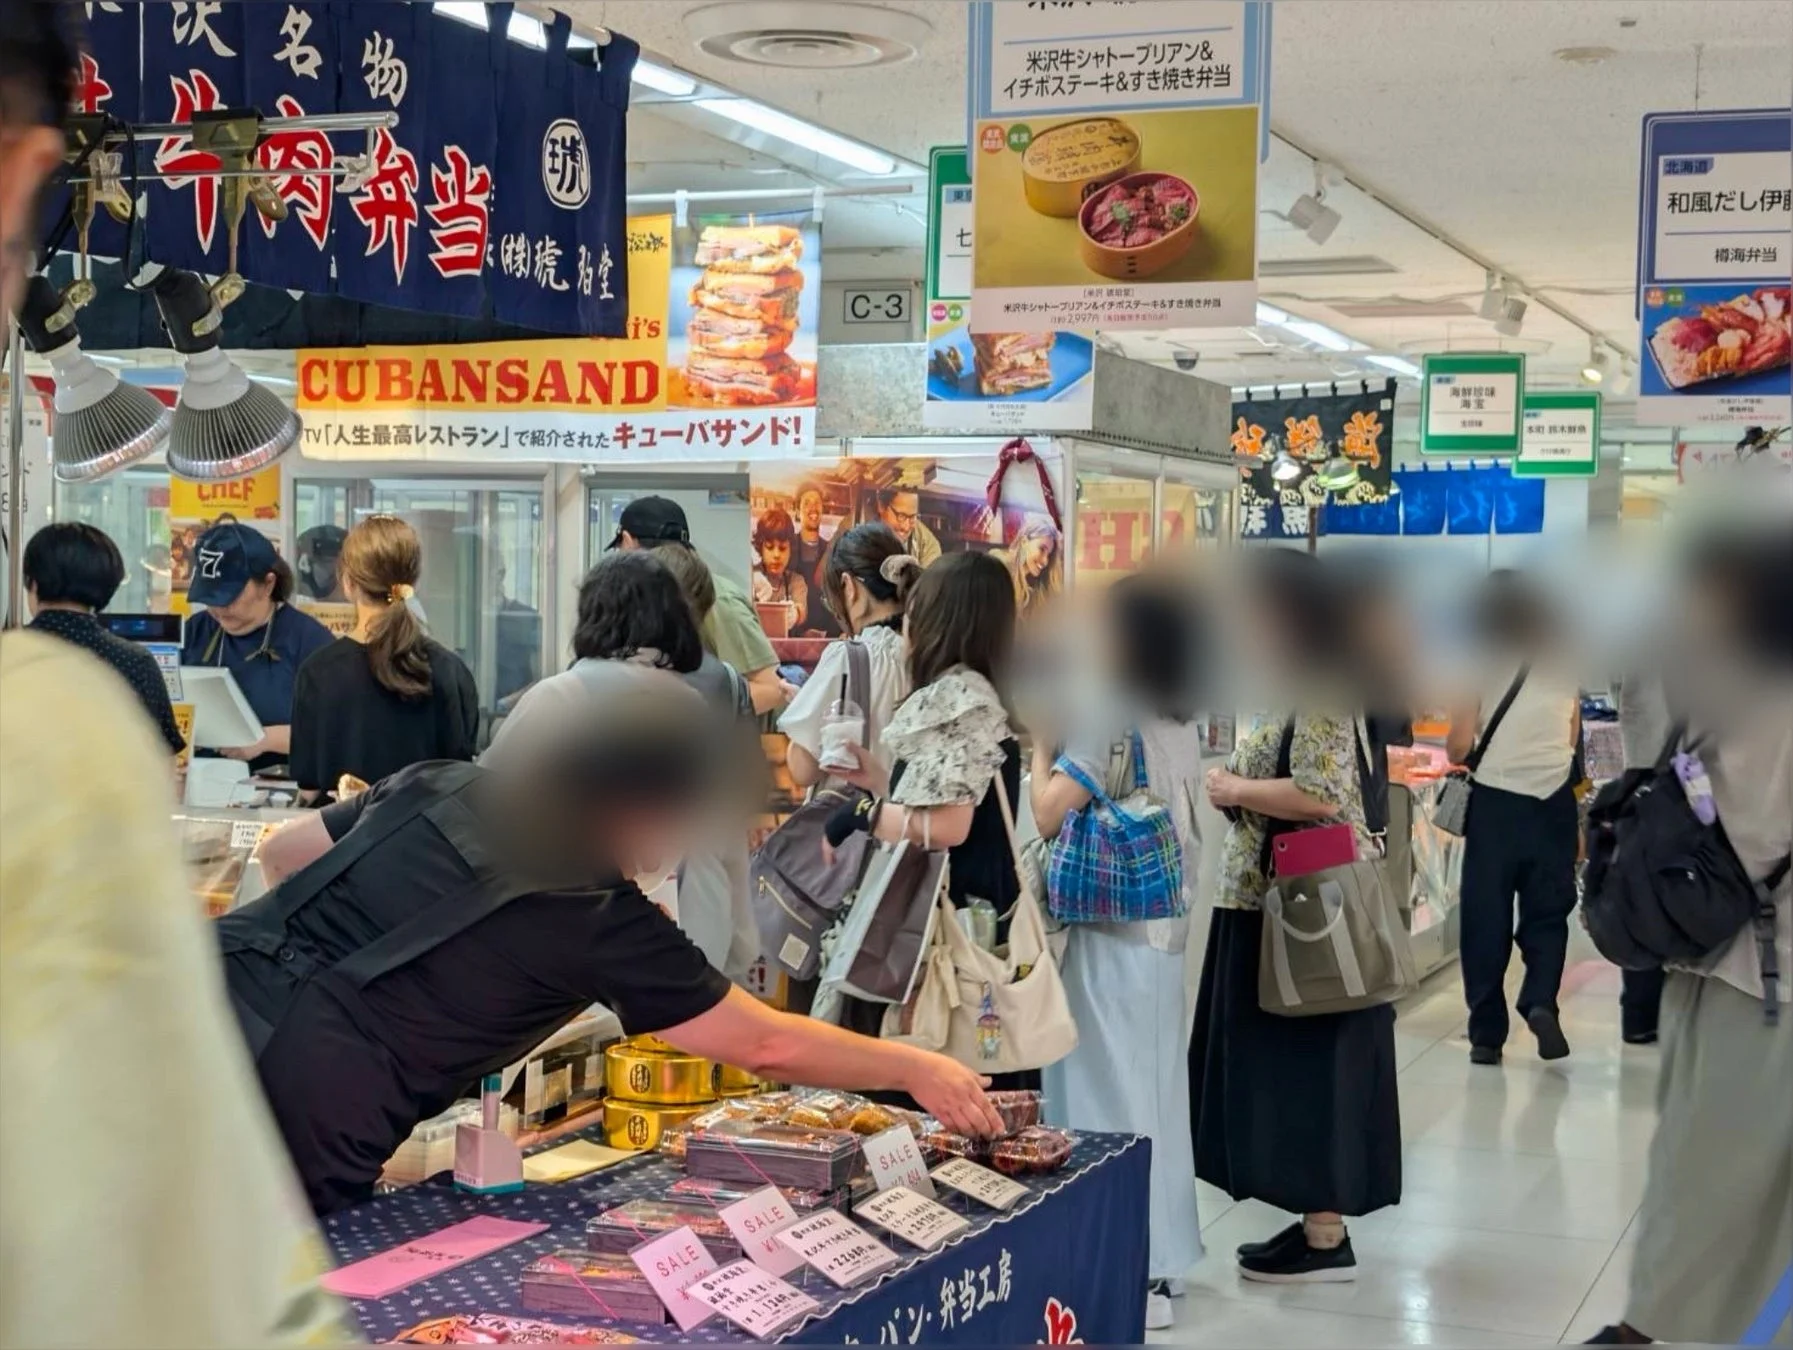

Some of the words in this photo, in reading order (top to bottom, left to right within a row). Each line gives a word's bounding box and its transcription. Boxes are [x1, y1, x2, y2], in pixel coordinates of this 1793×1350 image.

[84, 0, 407, 108] 沢名物
[1026, 40, 1214, 74] 米沢牛シャトーブリアン&
[1003, 63, 1231, 100] イチボステーキ&すき焼き弁当
[76, 52, 491, 286] 牛肉弁当
[1664, 159, 1710, 175] 北海道
[1714, 247, 1777, 263] 樽海弁当
[850, 293, 903, 319] C-3
[302, 358, 660, 404] CUBANSAND
[879, 1144, 914, 1171] SALE
[743, 1206, 785, 1234] SALE
[656, 1244, 700, 1278] SALE
